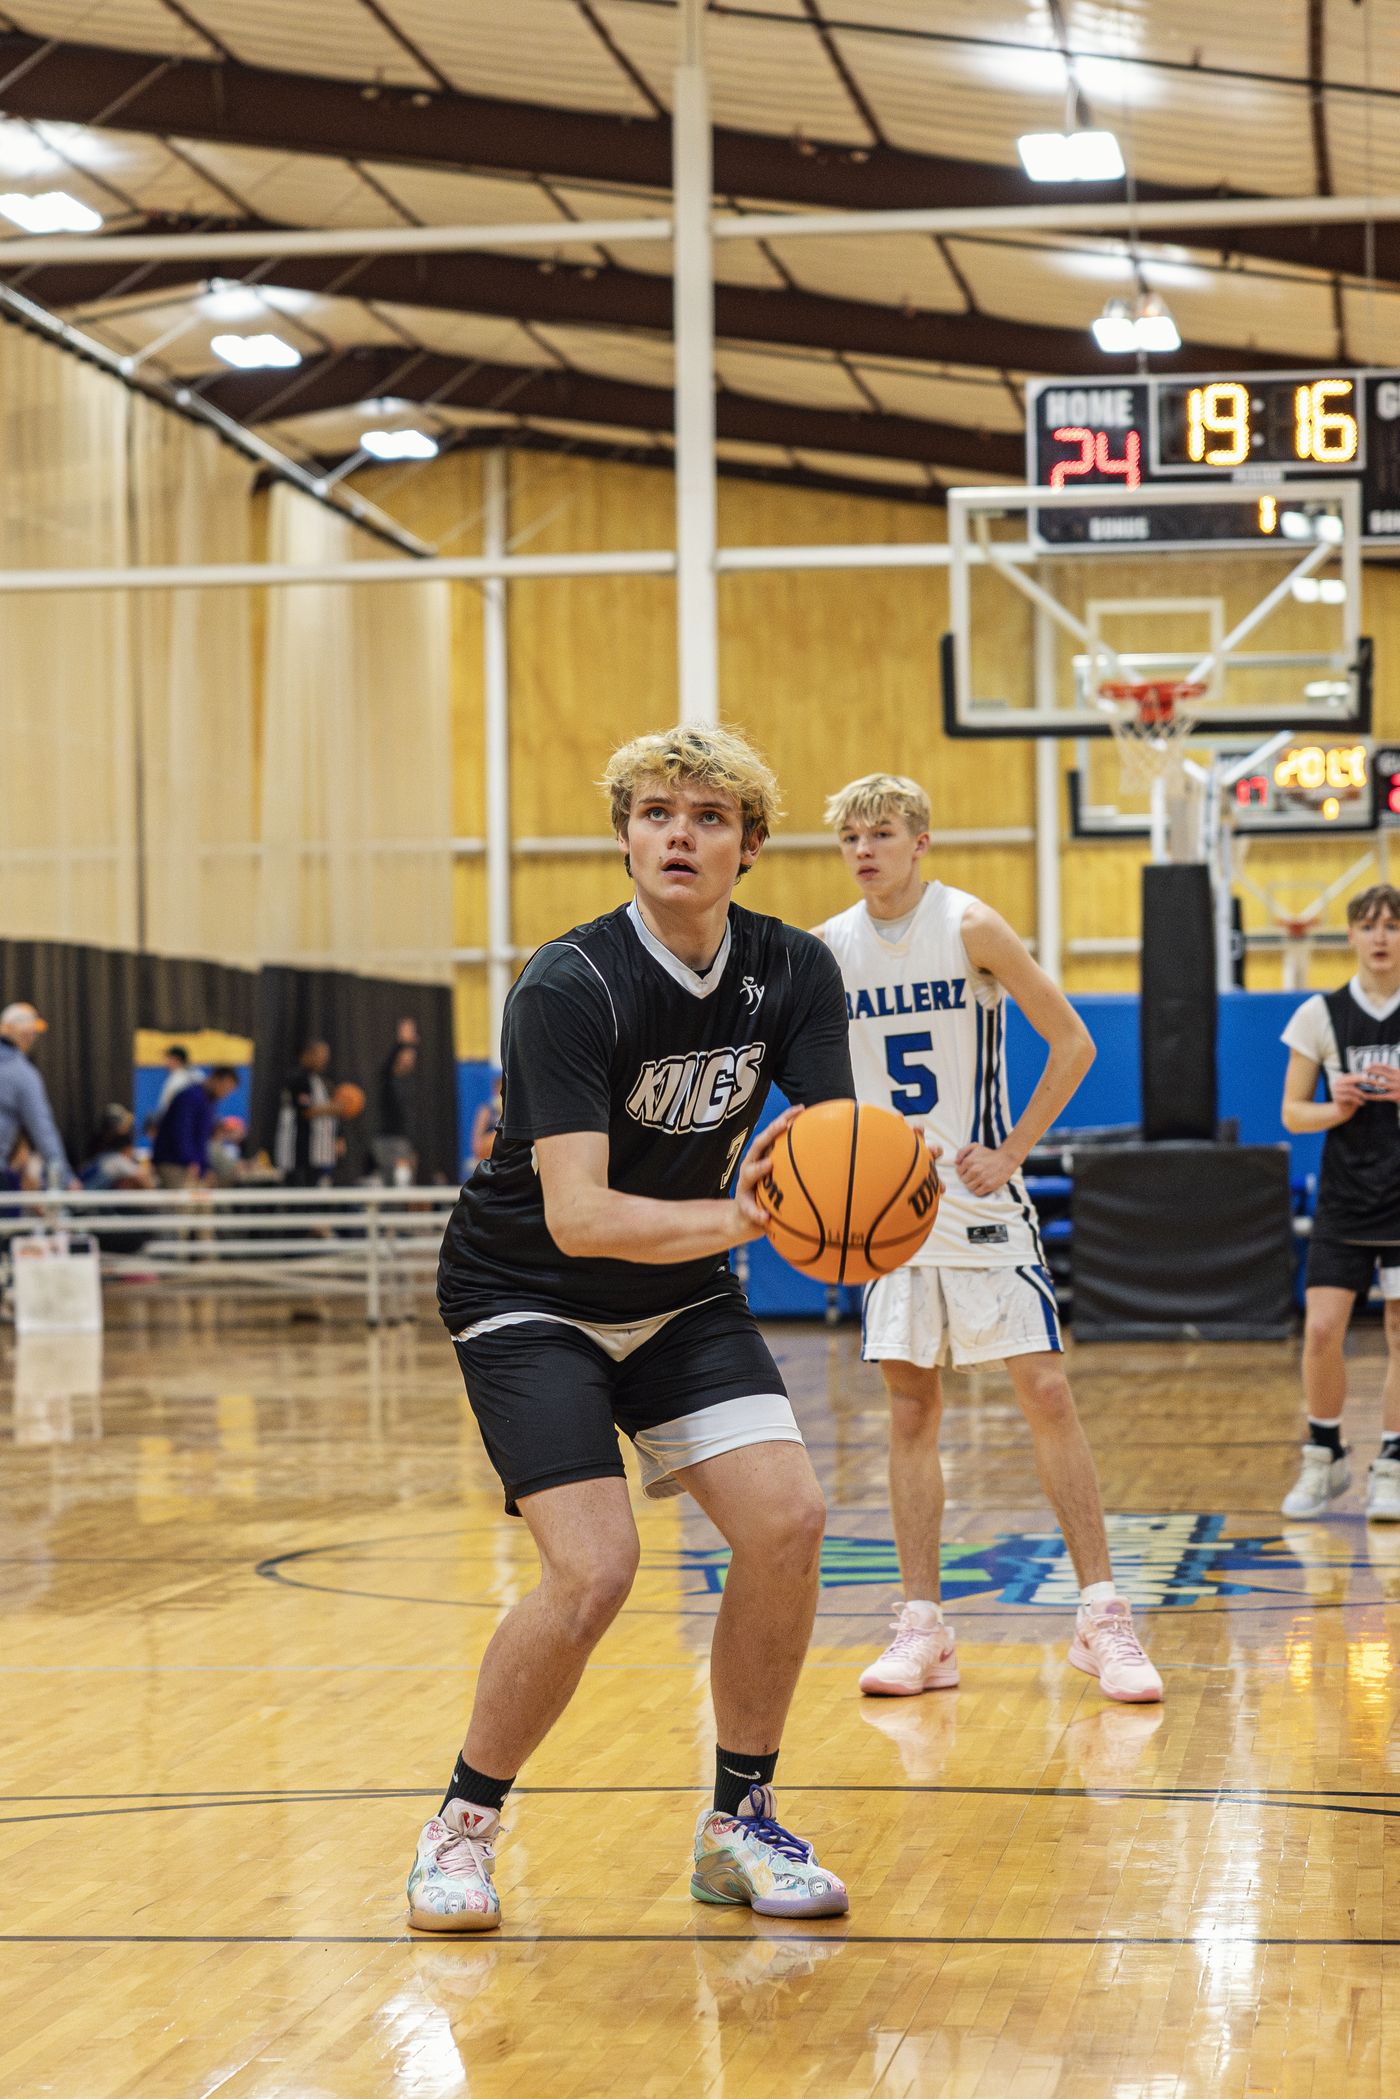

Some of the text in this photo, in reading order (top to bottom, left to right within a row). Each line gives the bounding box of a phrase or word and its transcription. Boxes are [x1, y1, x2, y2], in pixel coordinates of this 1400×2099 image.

[1046, 389, 1134, 427] HOME
[1050, 427, 1140, 493] 24
[625, 1042, 766, 1135] KINGS
[884, 1031, 939, 1116] 5
